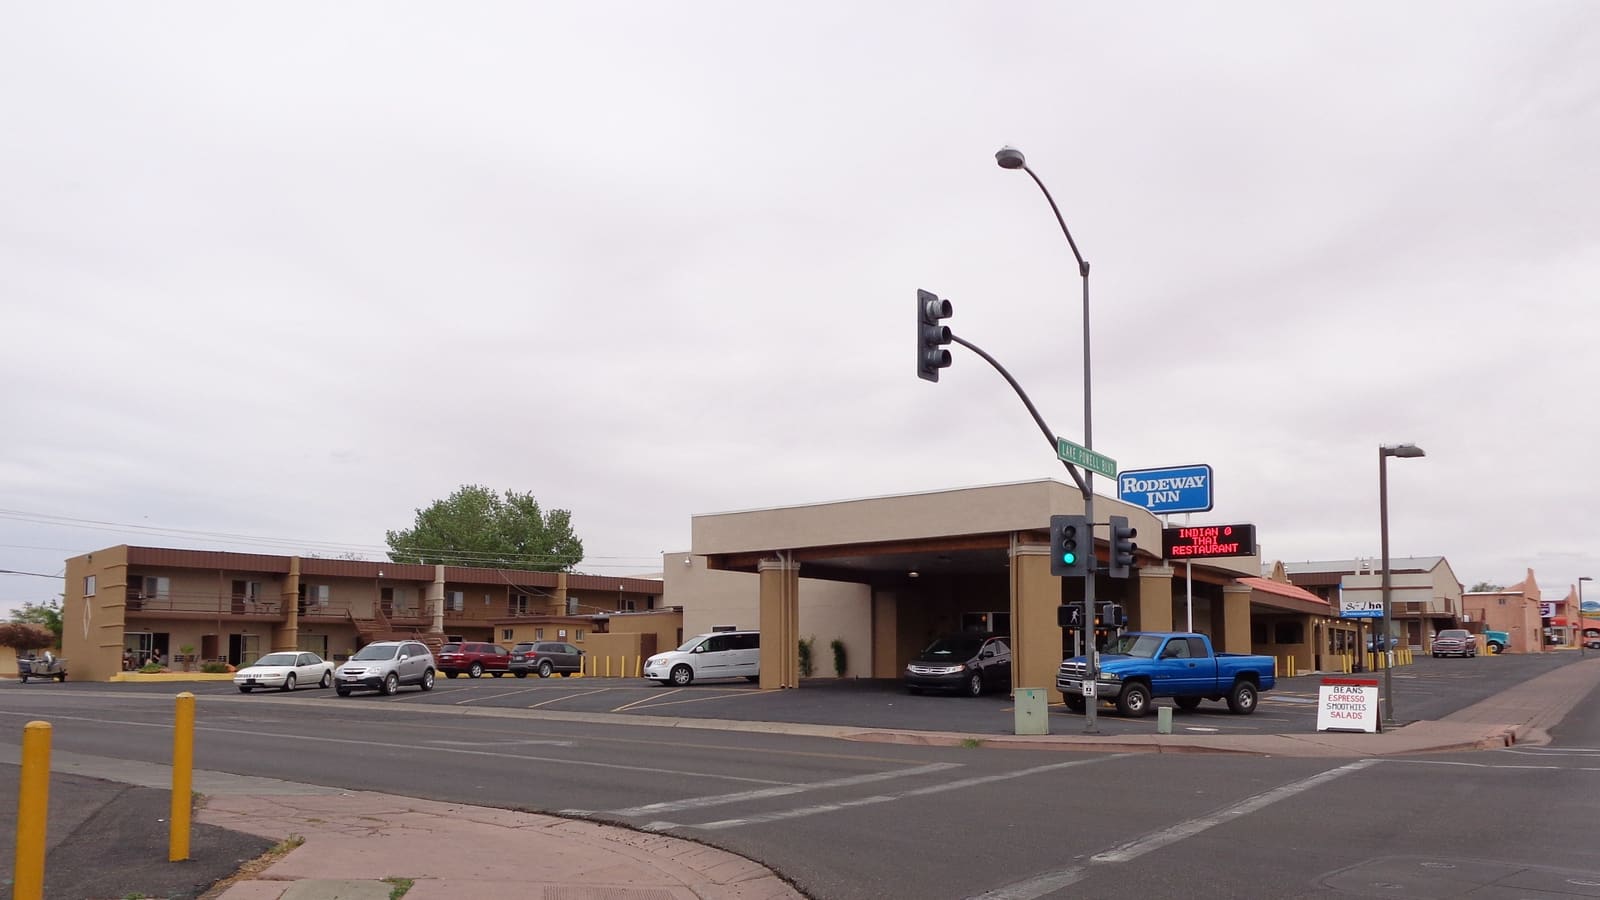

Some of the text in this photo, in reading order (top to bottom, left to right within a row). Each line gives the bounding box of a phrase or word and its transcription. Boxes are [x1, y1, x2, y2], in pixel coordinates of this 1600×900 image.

[1062, 443, 1114, 475] LAKE POWELL BLVD
[1122, 475, 1206, 493] RODEWAY
[1146, 490, 1180, 507] INN
[1179, 528, 1219, 538] INDIAN
[1192, 536, 1218, 545] THAI
[1172, 543, 1239, 555] RESTAURANT
[1333, 686, 1363, 694] BEANS
[1328, 694, 1365, 703] ESPRESSO
[1326, 703, 1367, 711] SMOOTHIES
[1330, 711, 1362, 719] SALADS
